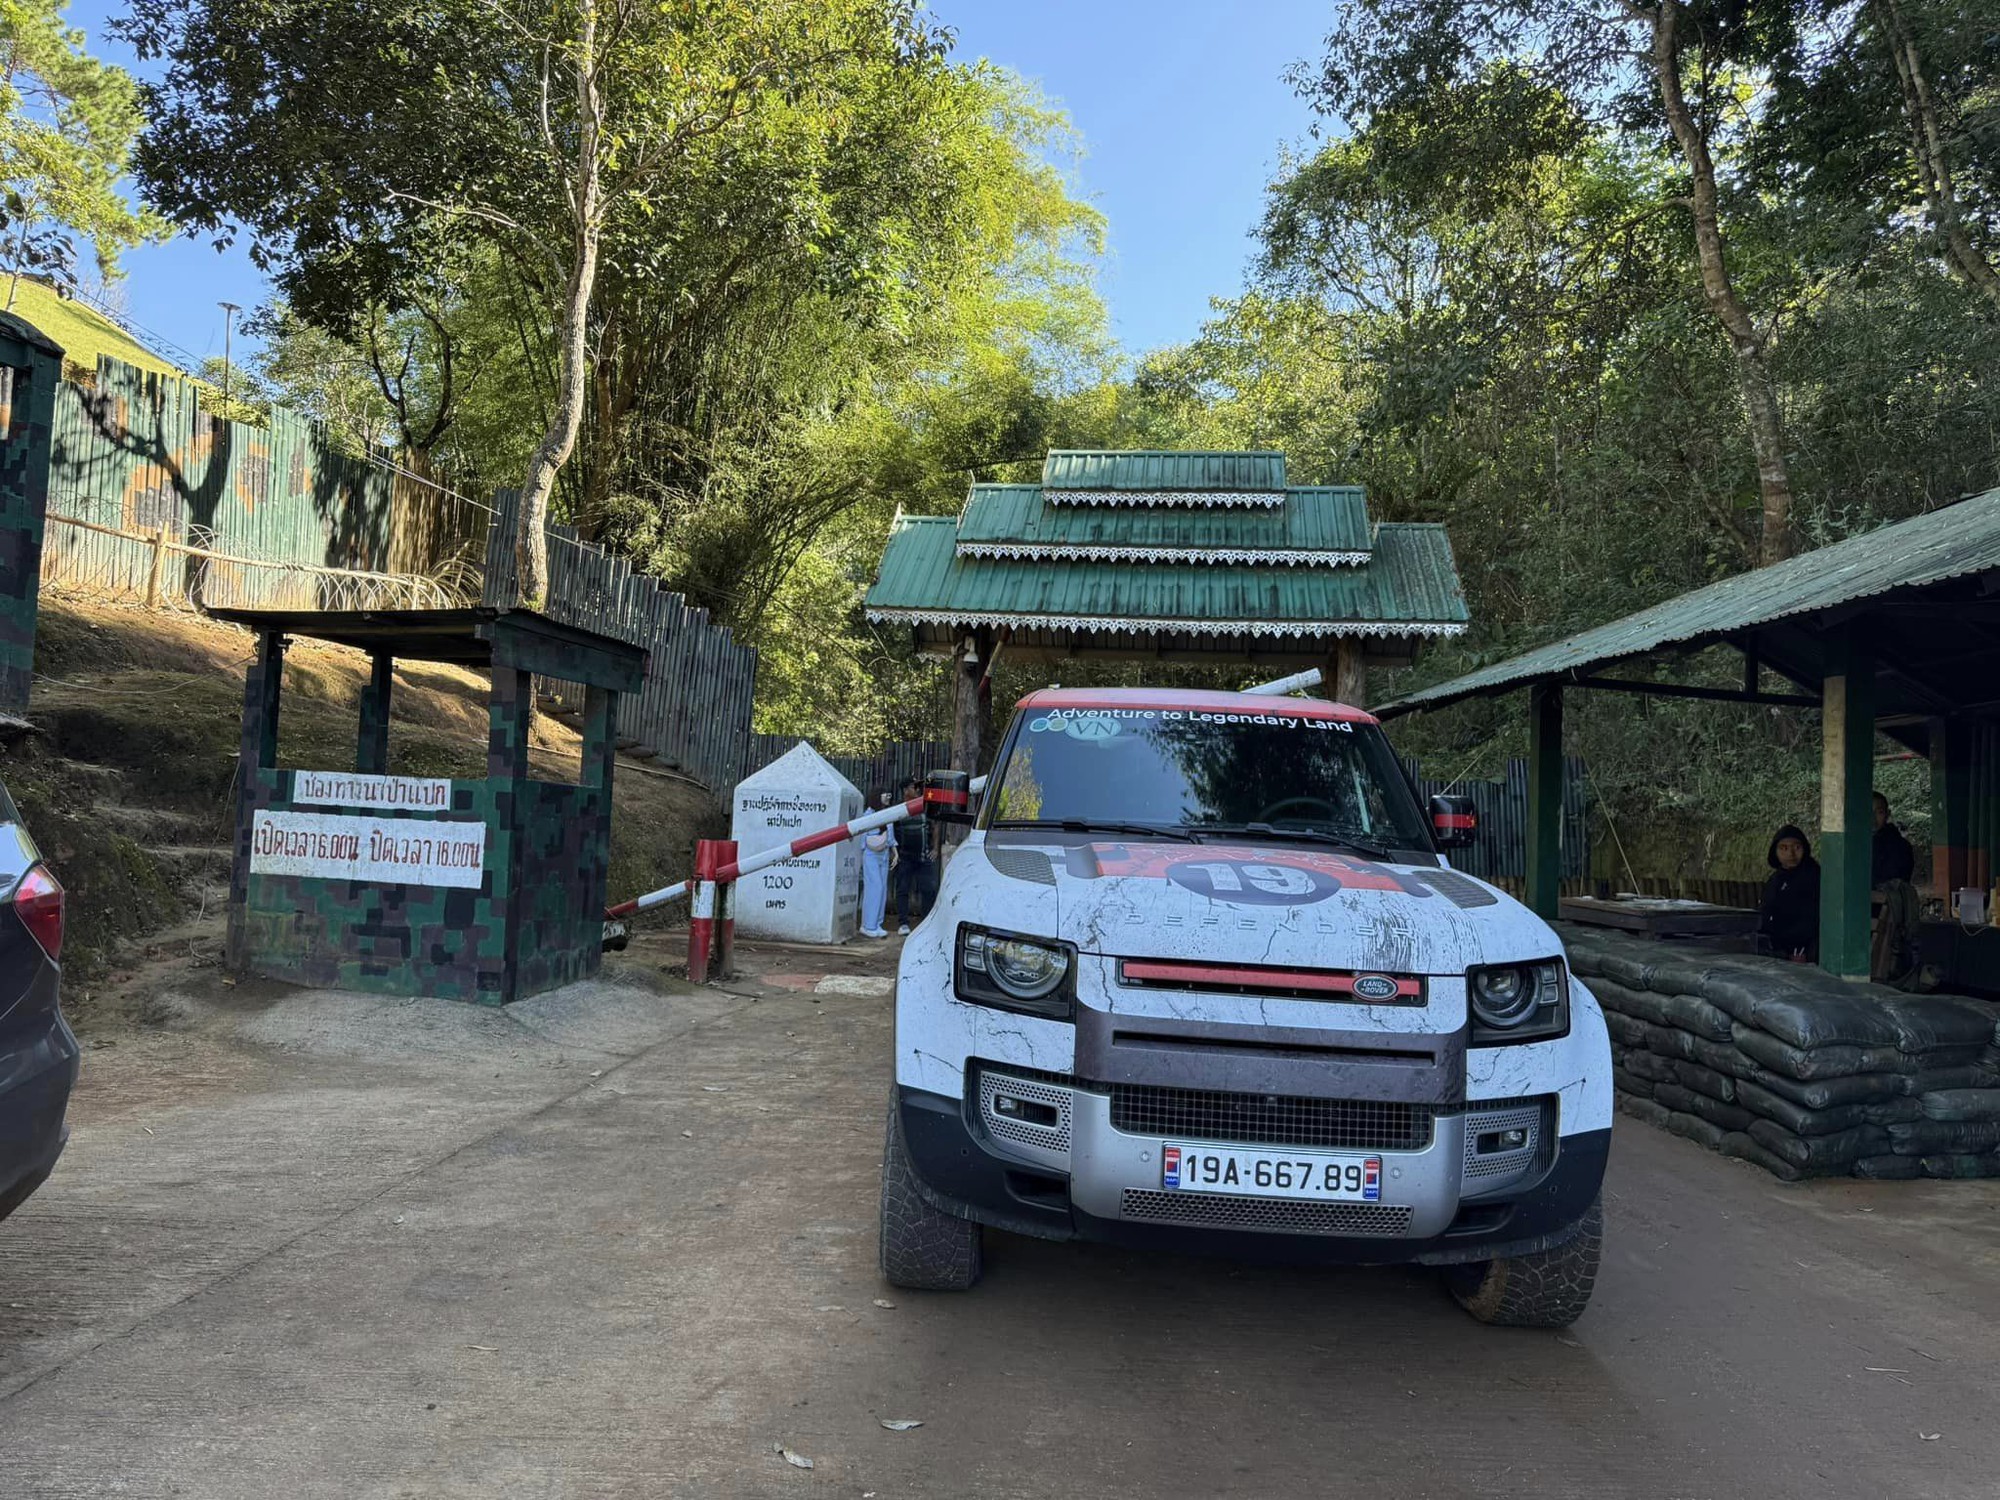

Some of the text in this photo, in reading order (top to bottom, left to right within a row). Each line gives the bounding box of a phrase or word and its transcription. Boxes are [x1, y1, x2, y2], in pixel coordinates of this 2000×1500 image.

[1047, 708, 1354, 733] Adventure to Legendary Land
[1075, 720, 1119, 736] VN
[763, 875, 794, 889] 1200
[1186, 863, 1317, 895] 19
[1125, 912, 1413, 940] DEFENDER
[1186, 1154, 1362, 1192] 19A-667.89
